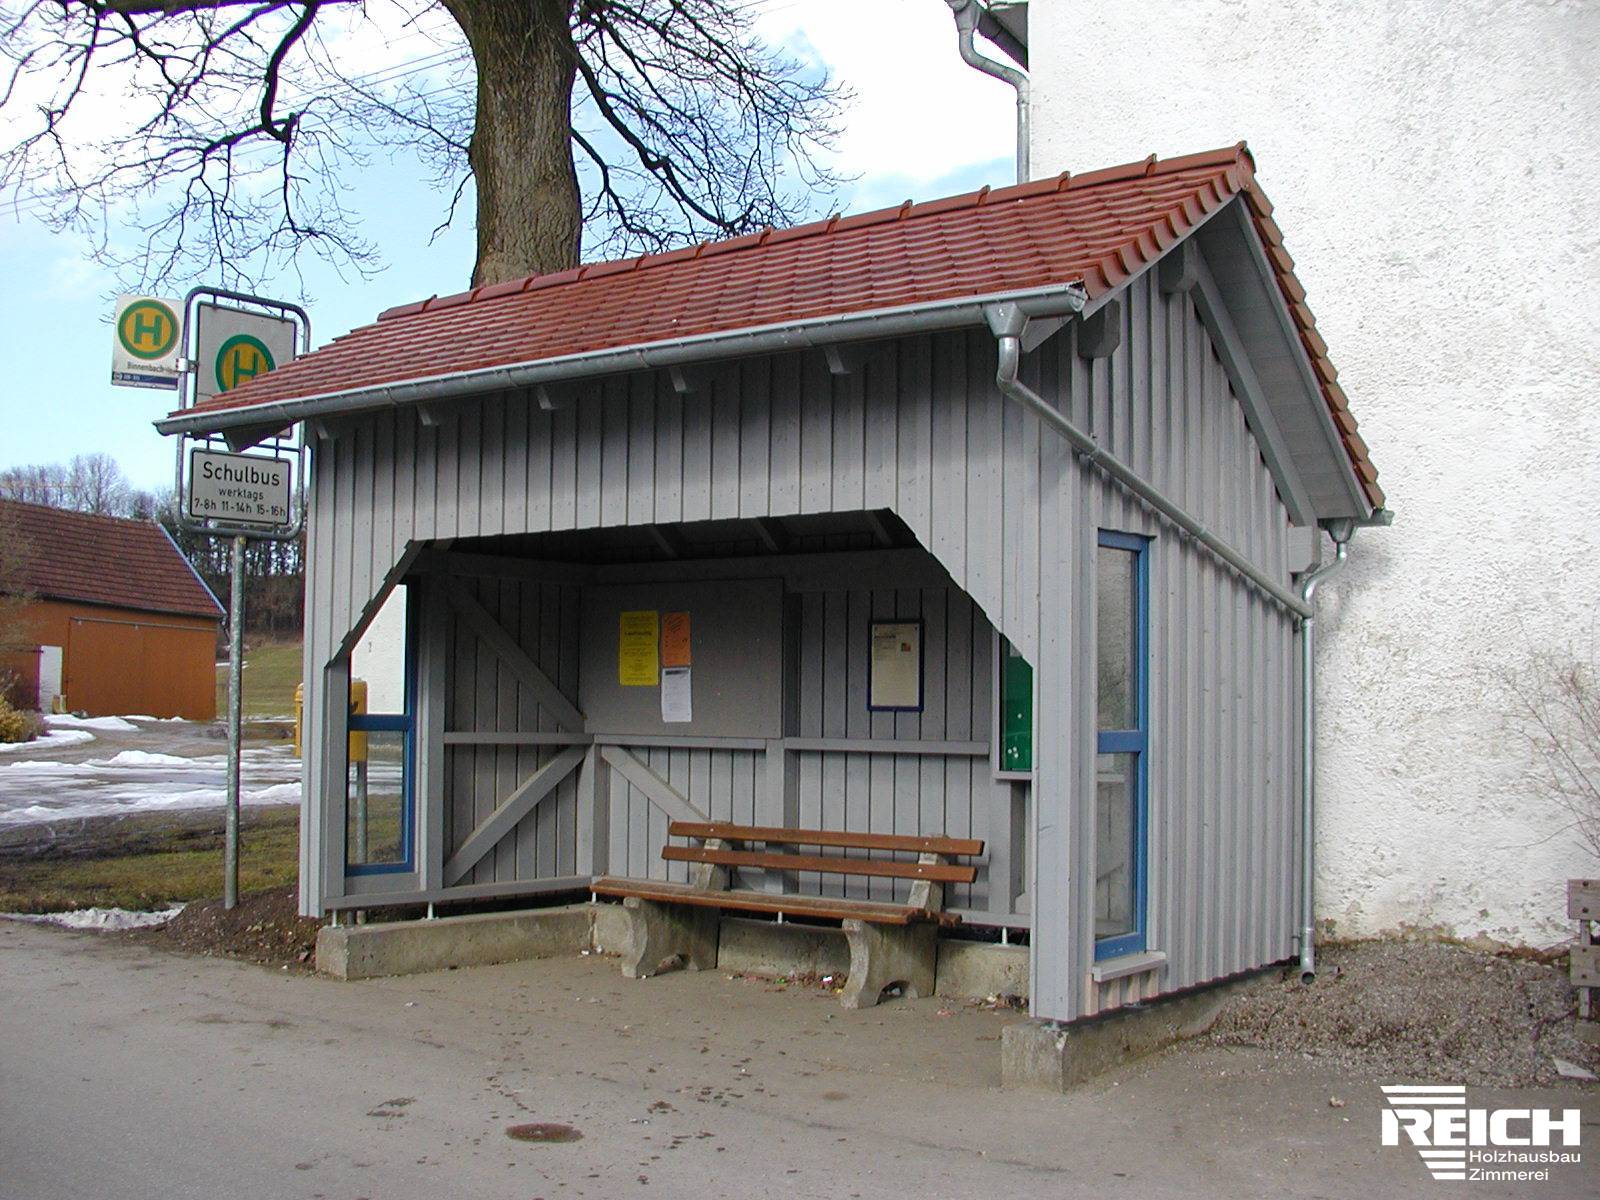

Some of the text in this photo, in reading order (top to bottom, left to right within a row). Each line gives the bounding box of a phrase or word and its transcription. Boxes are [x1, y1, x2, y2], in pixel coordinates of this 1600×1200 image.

[133, 312, 163, 346] H
[233, 349, 259, 388] H
[203, 461, 280, 487] Schulbus
[219, 487, 264, 502] werktags
